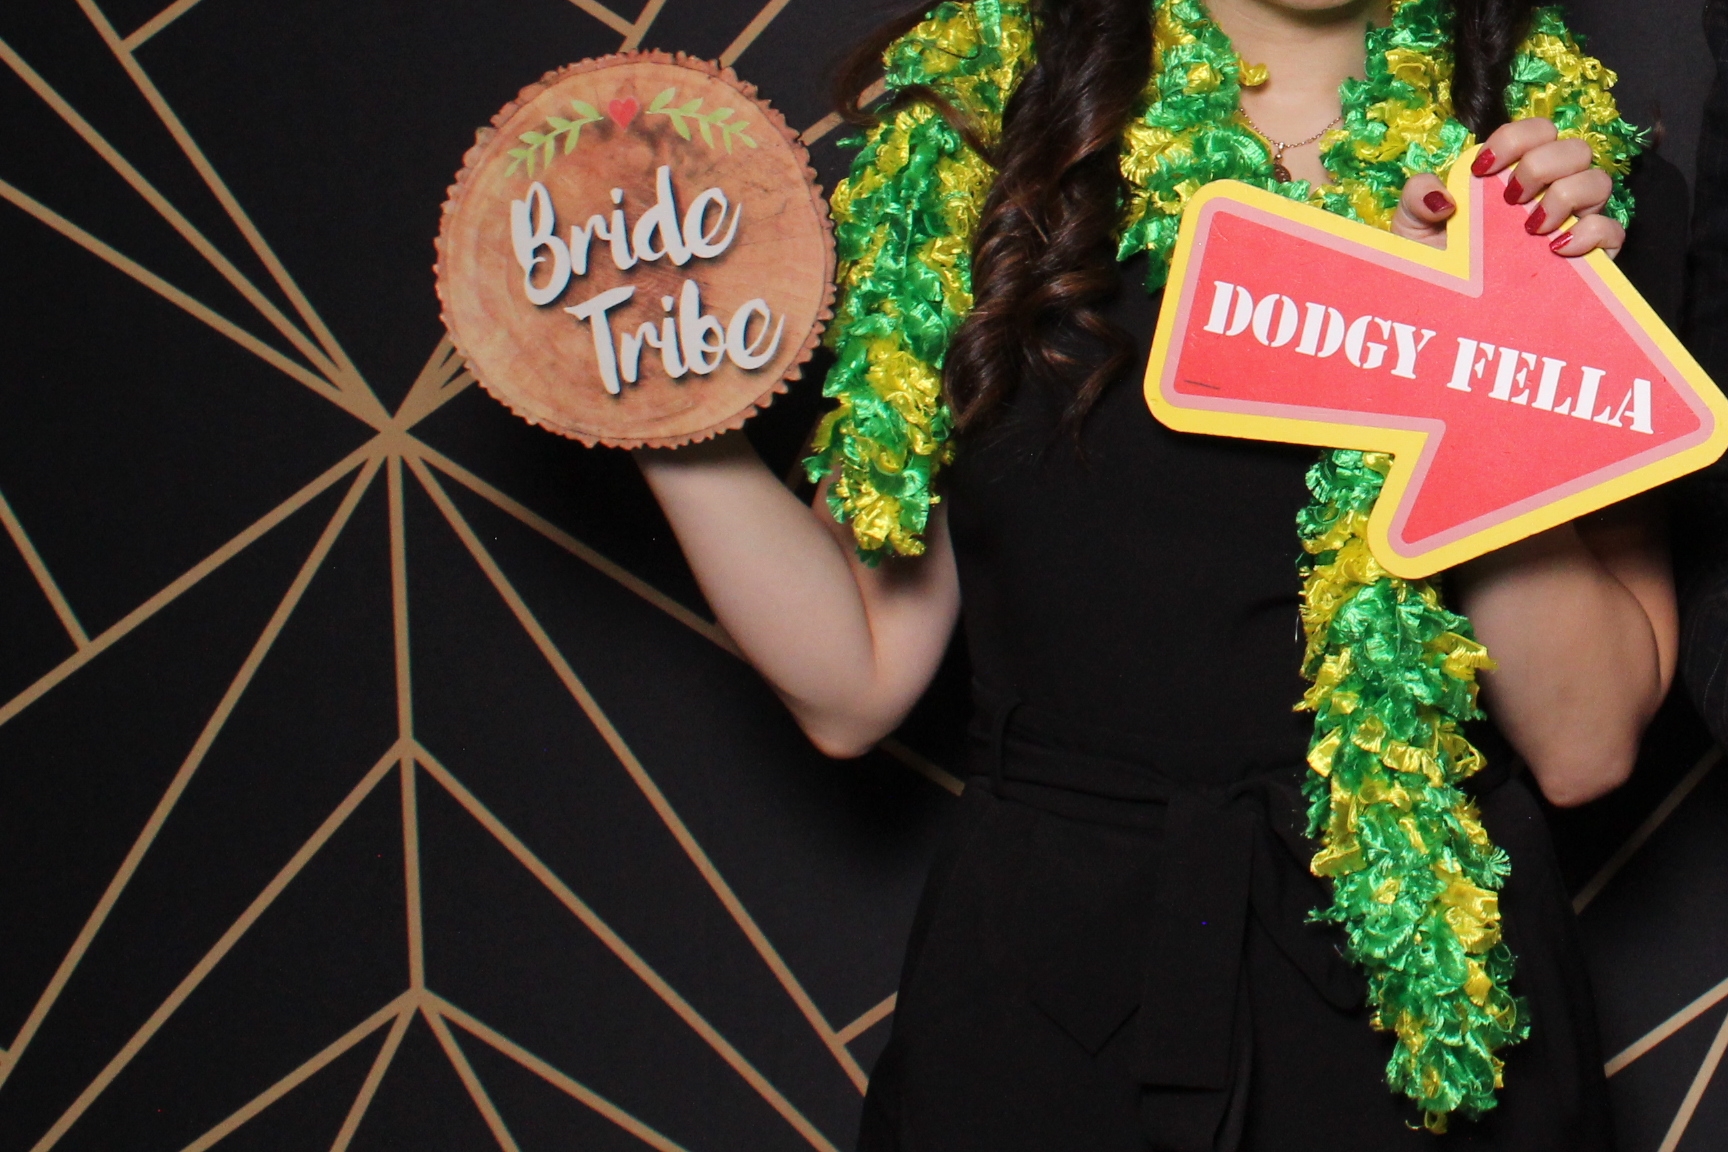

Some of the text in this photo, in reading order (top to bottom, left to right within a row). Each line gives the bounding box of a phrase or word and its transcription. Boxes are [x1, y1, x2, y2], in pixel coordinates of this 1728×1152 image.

[511, 165, 742, 305] Bride
[564, 279, 784, 395] Tribe
[1203, 281, 1655, 435] DODGY FELLA
